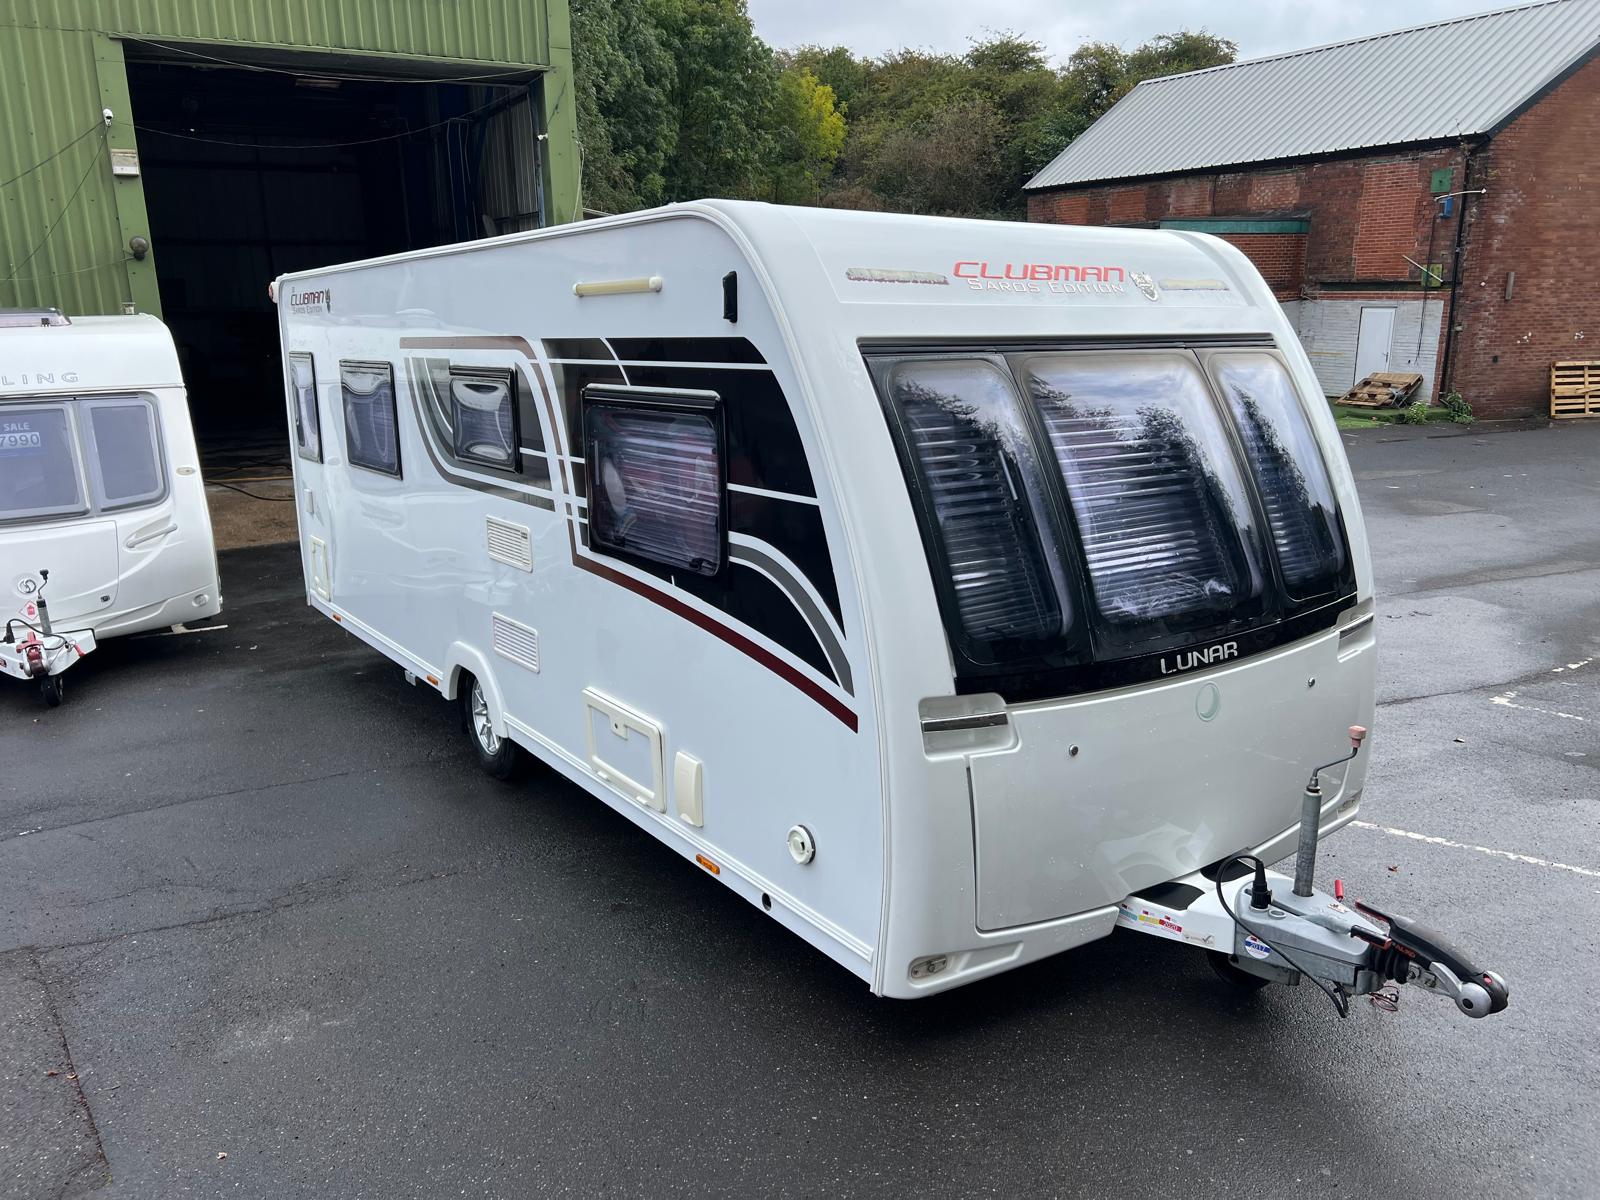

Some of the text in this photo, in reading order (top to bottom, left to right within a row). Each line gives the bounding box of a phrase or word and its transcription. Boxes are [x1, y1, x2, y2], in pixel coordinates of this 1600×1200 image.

[953, 261, 1124, 282] CLUBMAN
[291, 290, 325, 306] CLUBMAN
[3, 422, 31, 432] SALE
[1160, 641, 1238, 674] LUNAR
